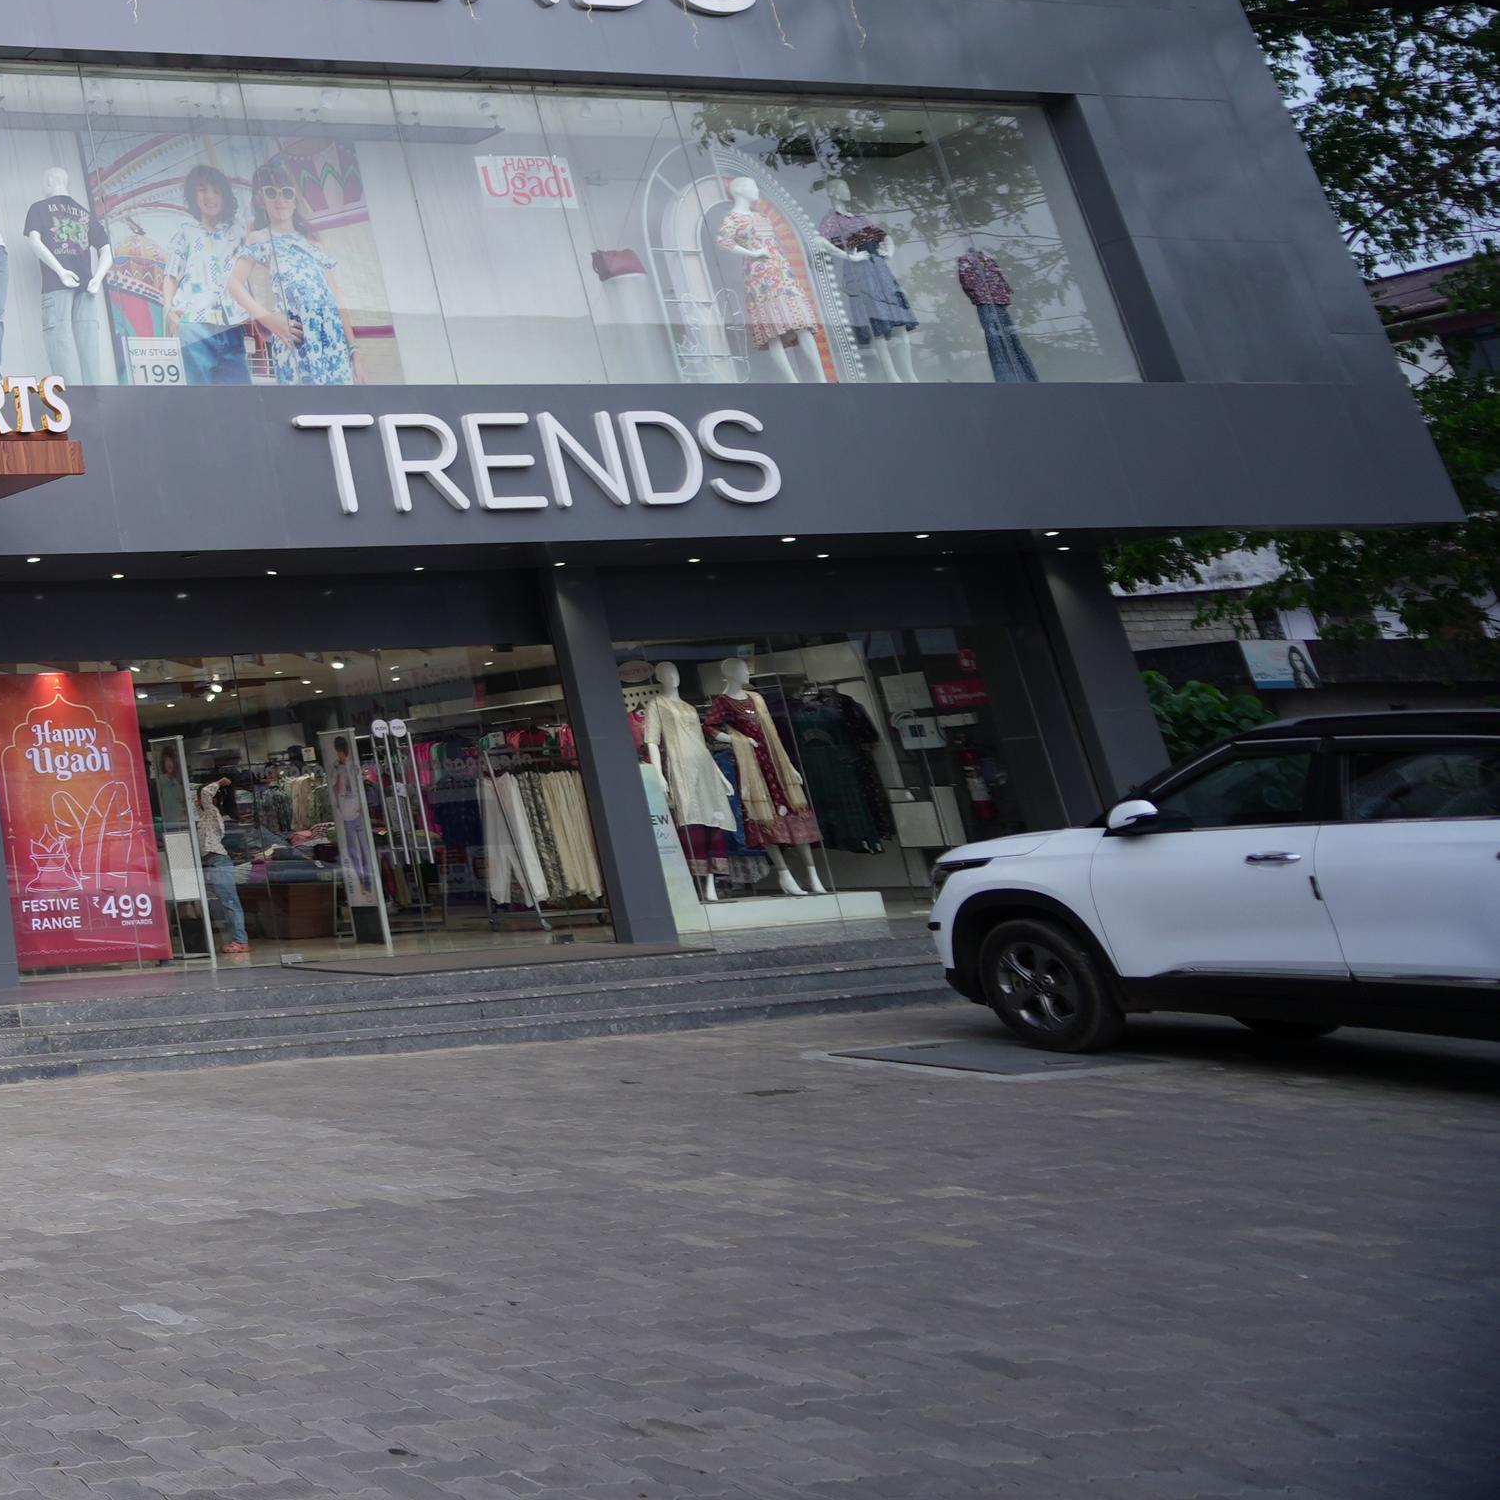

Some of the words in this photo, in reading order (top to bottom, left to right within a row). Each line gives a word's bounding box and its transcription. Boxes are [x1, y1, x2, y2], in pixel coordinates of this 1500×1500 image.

[504, 157, 553, 172] HAPPY
[481, 165, 573, 206] Ugadi
[128, 348, 147, 357] NEW
[148, 348, 178, 357] STYLES
[291, 408, 782, 515] TRENDS
[31, 719, 97, 750] Happy
[25, 744, 112, 781] Ugadi
[22, 897, 80, 913] FESTIVE
[31, 916, 82, 930] RANGE
[121, 918, 153, 926] ONWARDS
